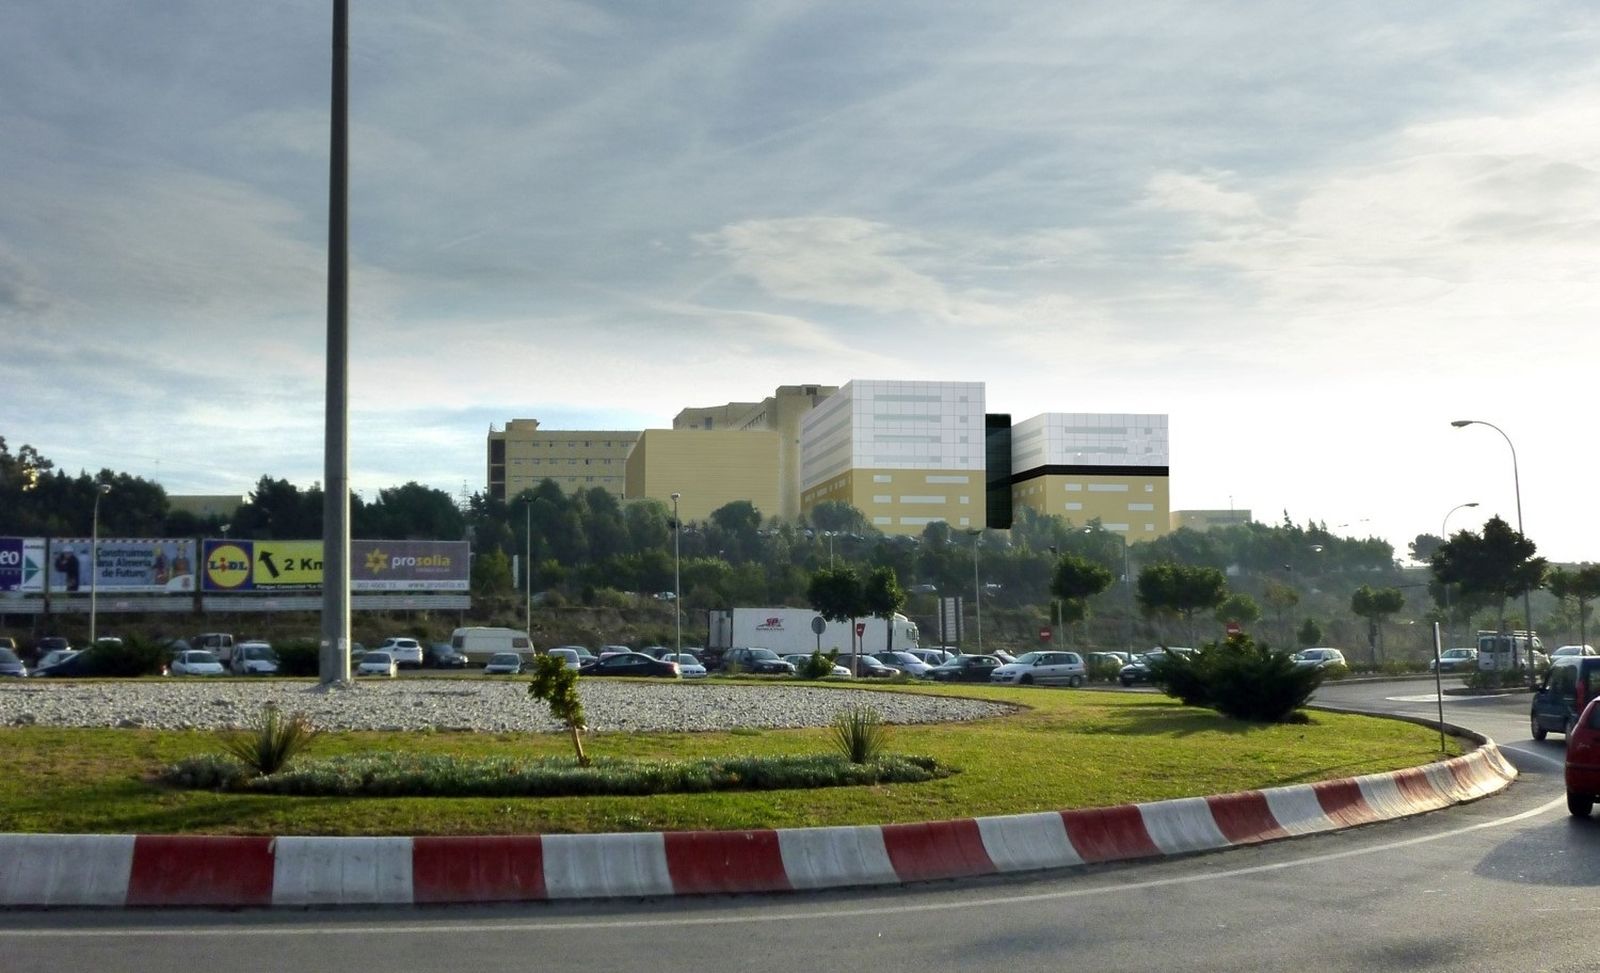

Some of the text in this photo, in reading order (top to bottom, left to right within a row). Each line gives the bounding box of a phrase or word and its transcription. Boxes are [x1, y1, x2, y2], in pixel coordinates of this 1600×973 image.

[284, 558, 294, 571] 2
[391, 554, 451, 570] prosolia
[102, 568, 145, 577] de Futuro
